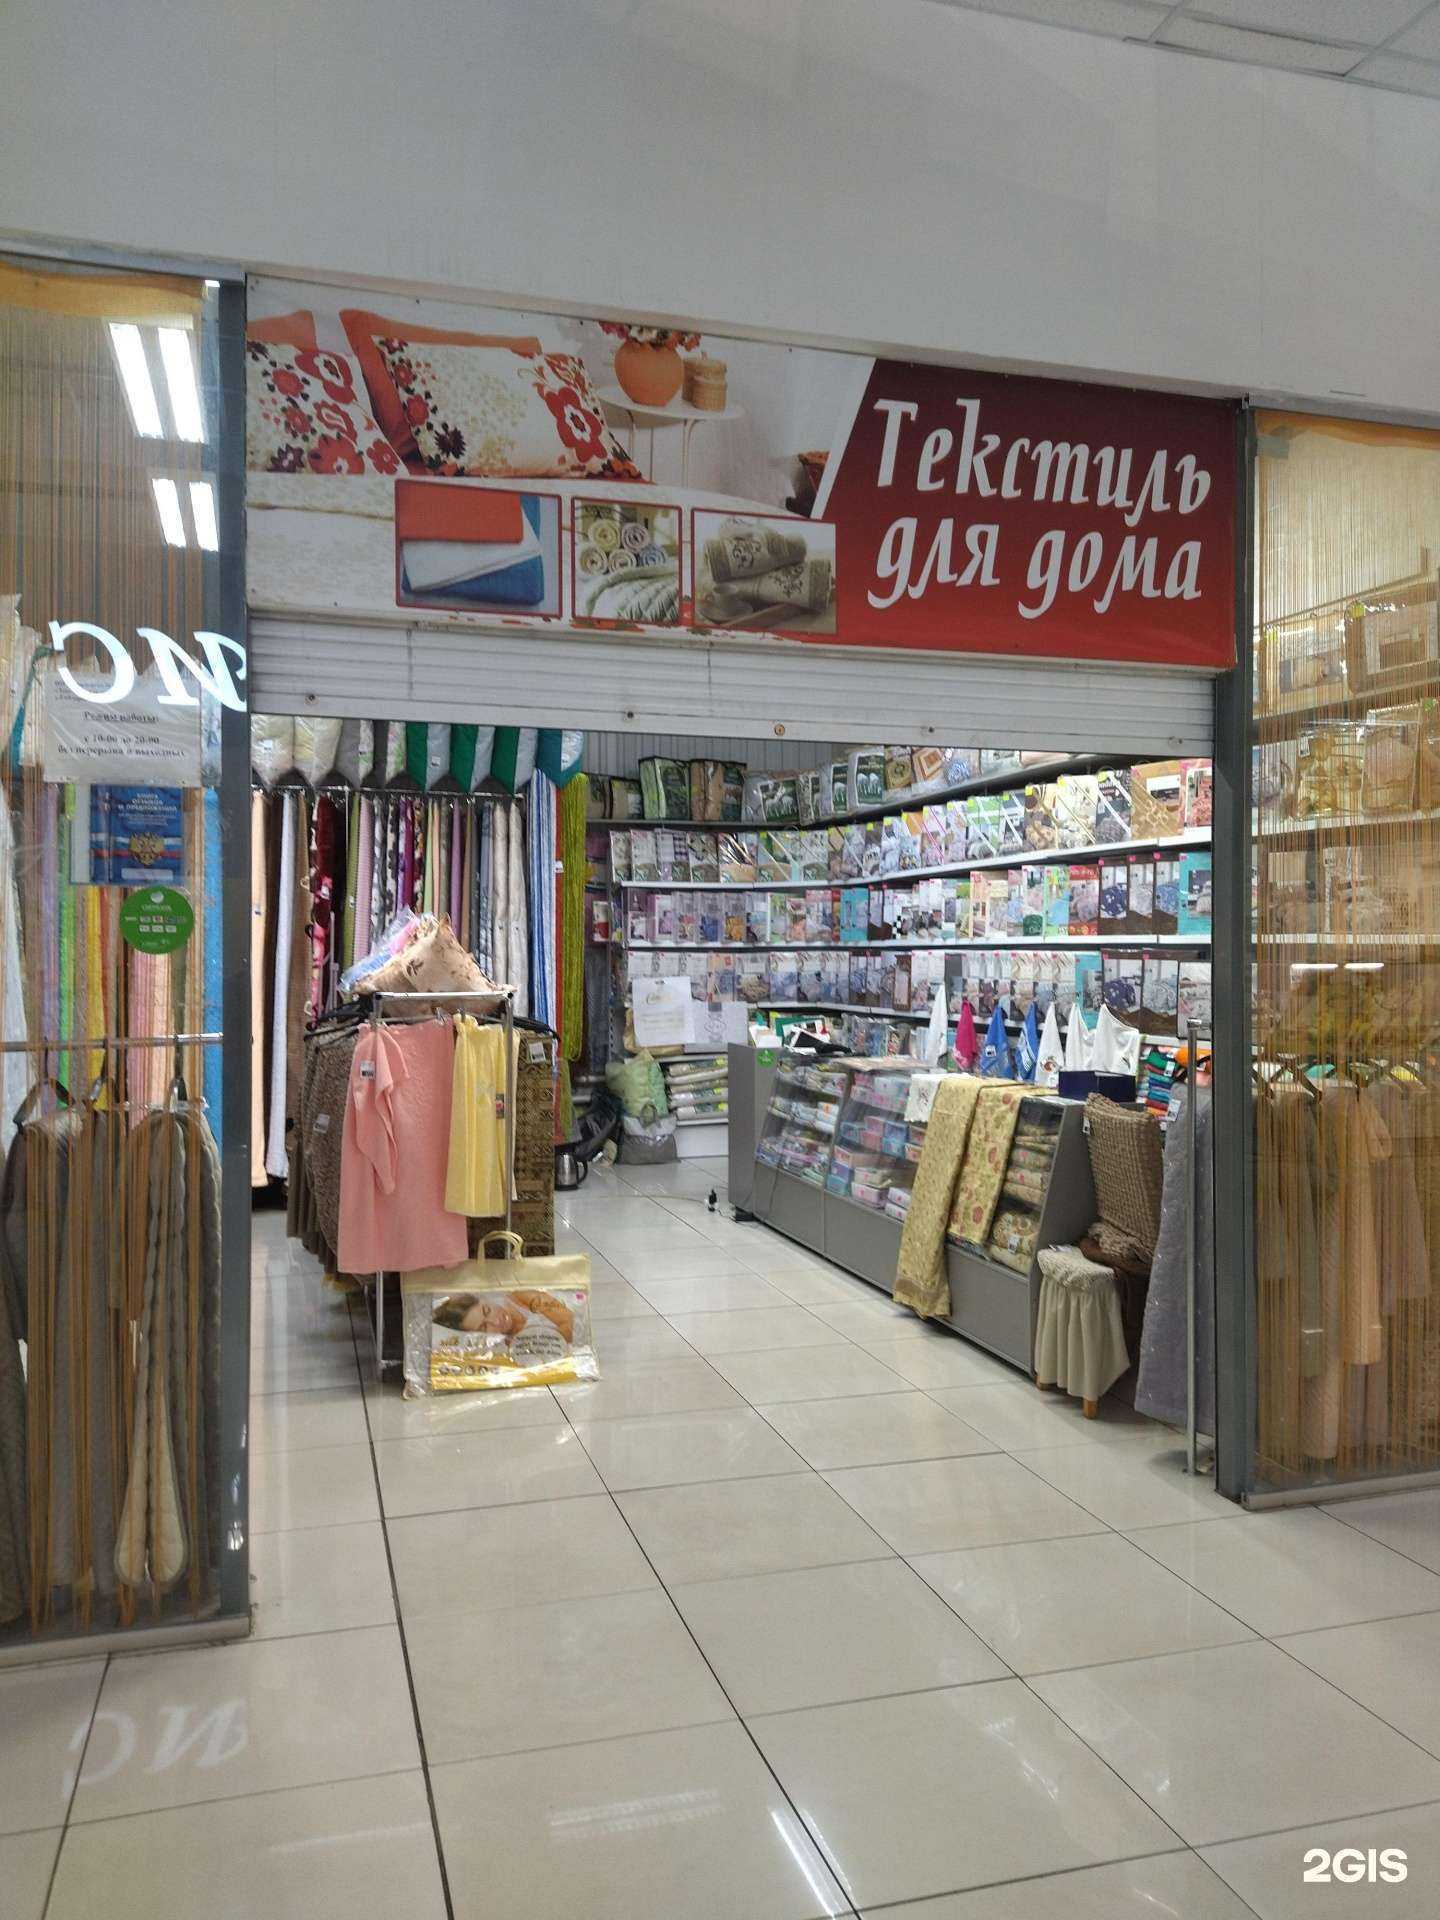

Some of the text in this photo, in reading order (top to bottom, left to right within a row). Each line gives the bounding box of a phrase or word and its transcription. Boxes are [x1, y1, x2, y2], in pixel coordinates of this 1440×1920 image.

[873, 397, 1212, 528] Текстиль
[867, 516, 1203, 620] для дома
